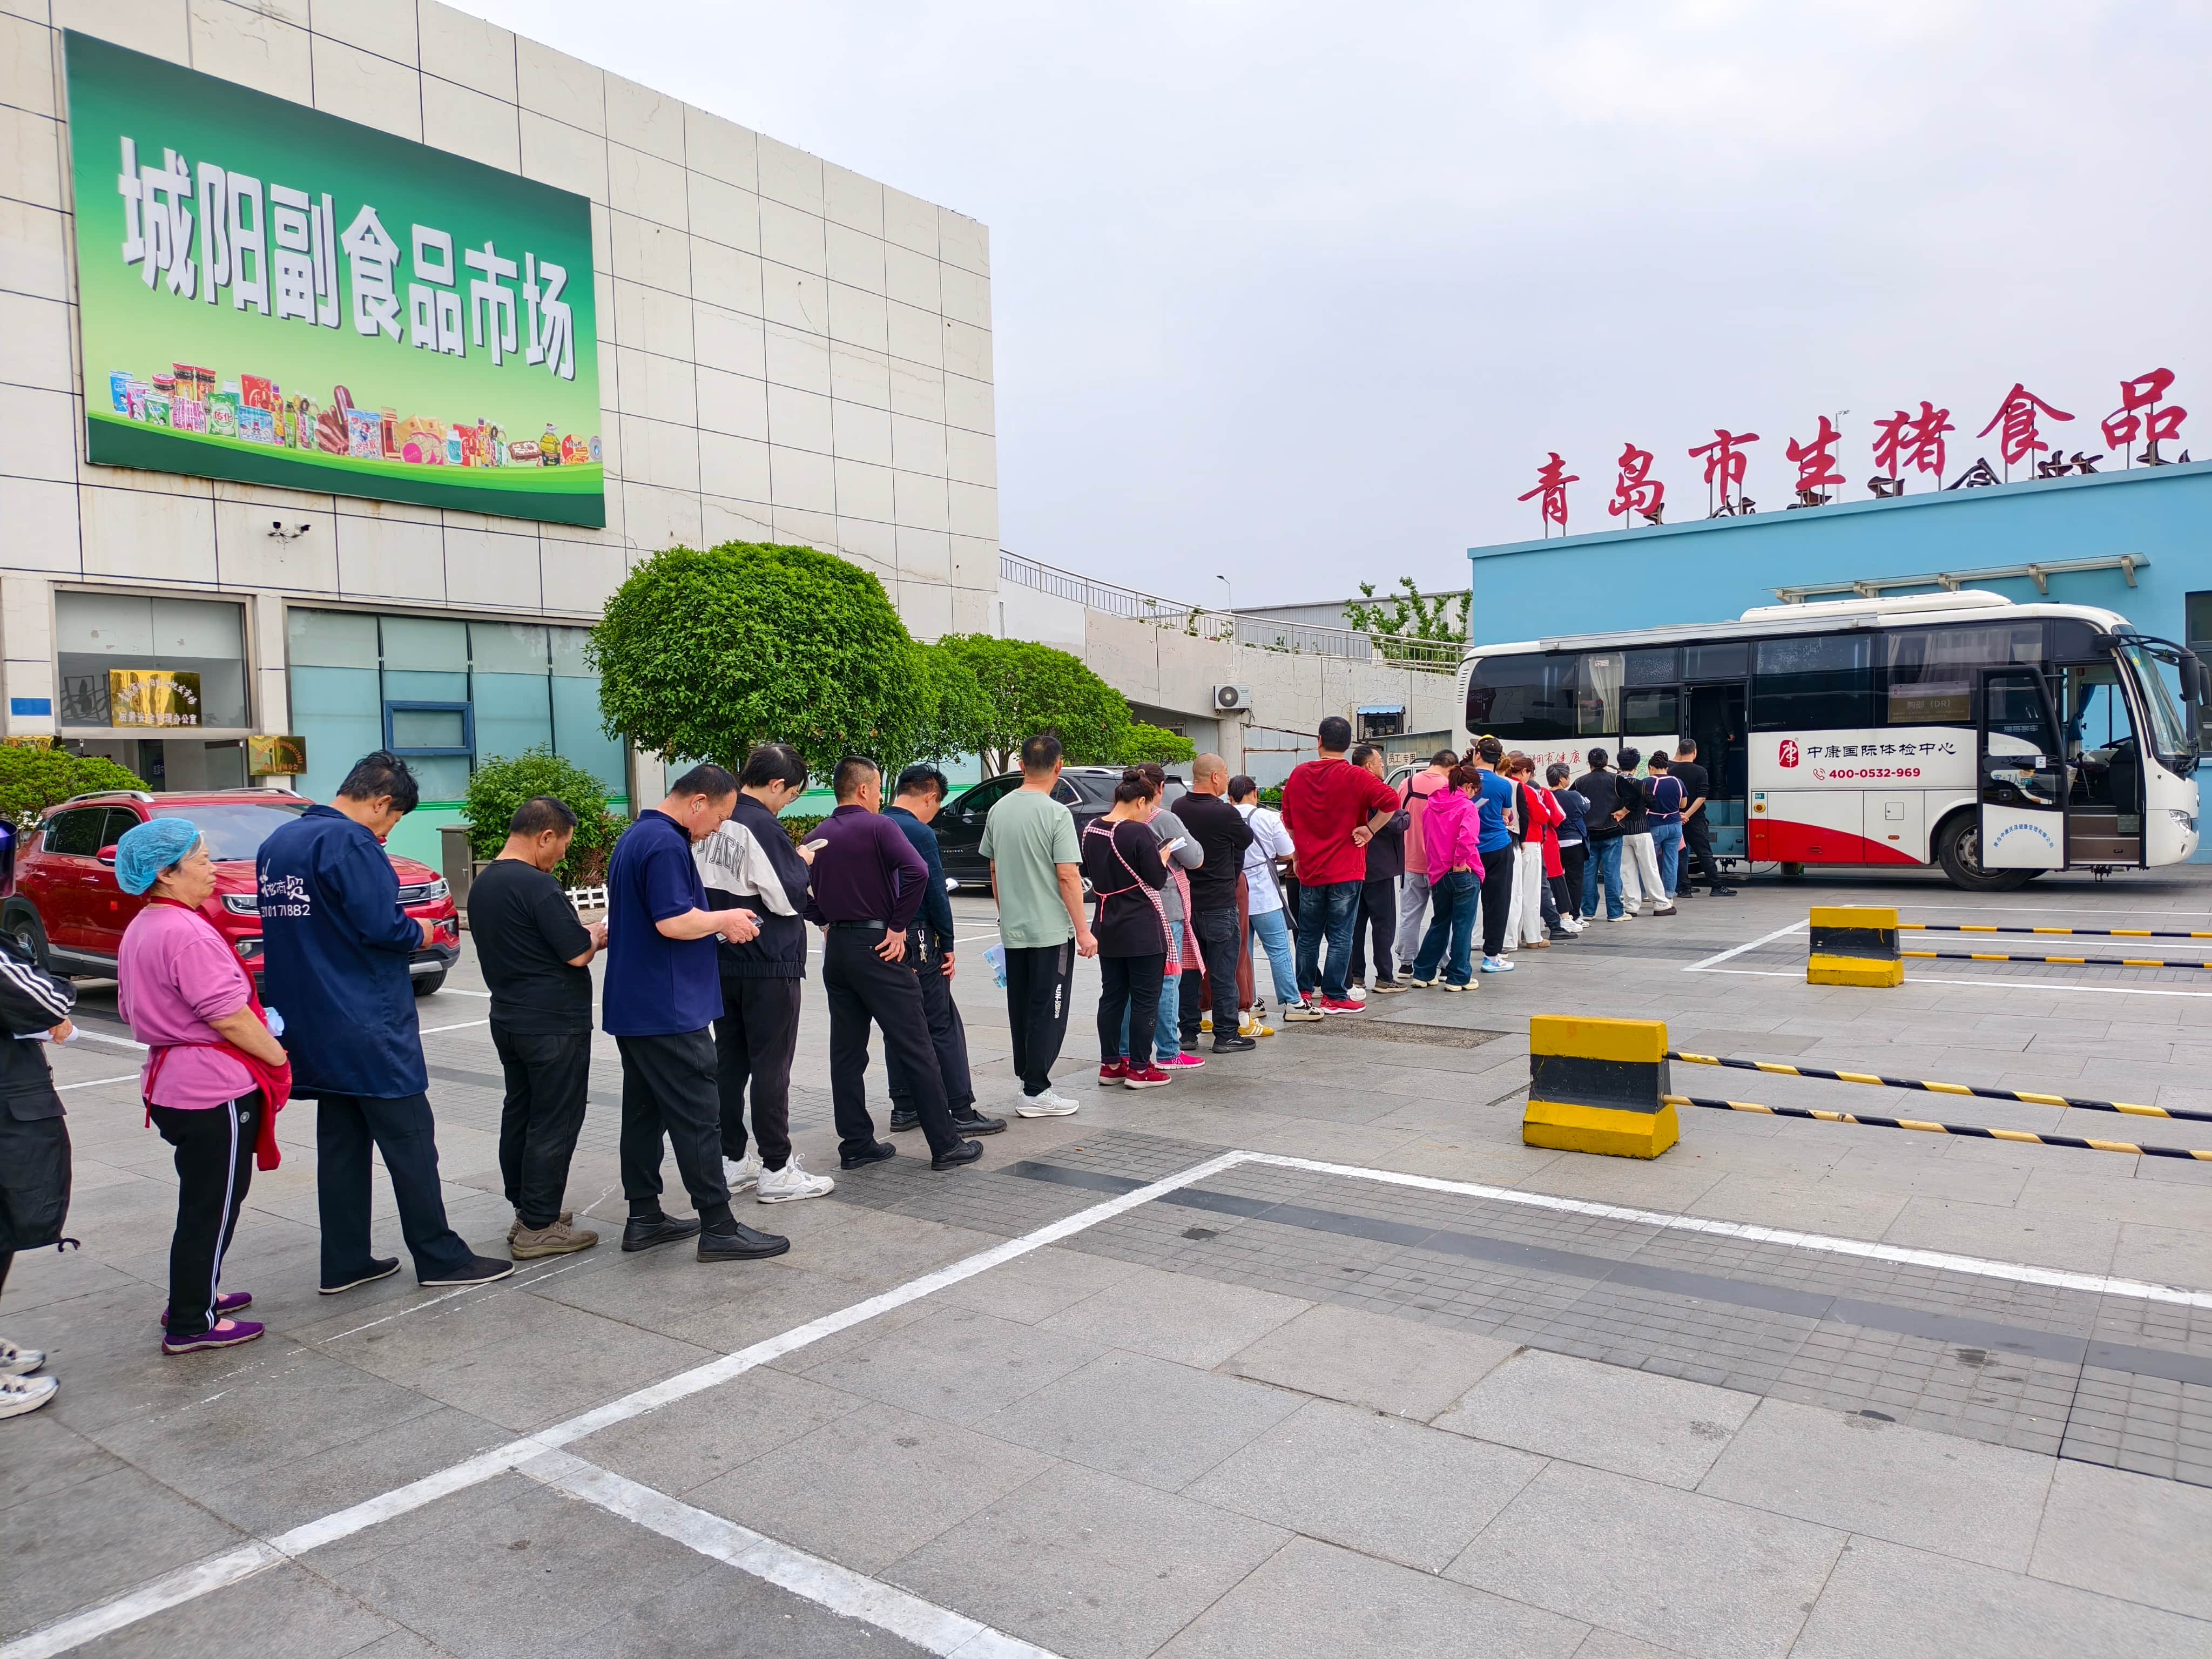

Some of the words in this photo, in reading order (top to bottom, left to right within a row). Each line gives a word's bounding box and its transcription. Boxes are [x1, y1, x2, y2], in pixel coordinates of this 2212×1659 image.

[118, 136, 576, 381] 城阳副食品市场
[1518, 367, 2189, 526] 青岛市生猪食品
[119, 712, 197, 724] 质量安全管理办公室
[1808, 743, 1957, 758] 中康国际体检中心
[1829, 767, 1921, 779] 400-0532-969
